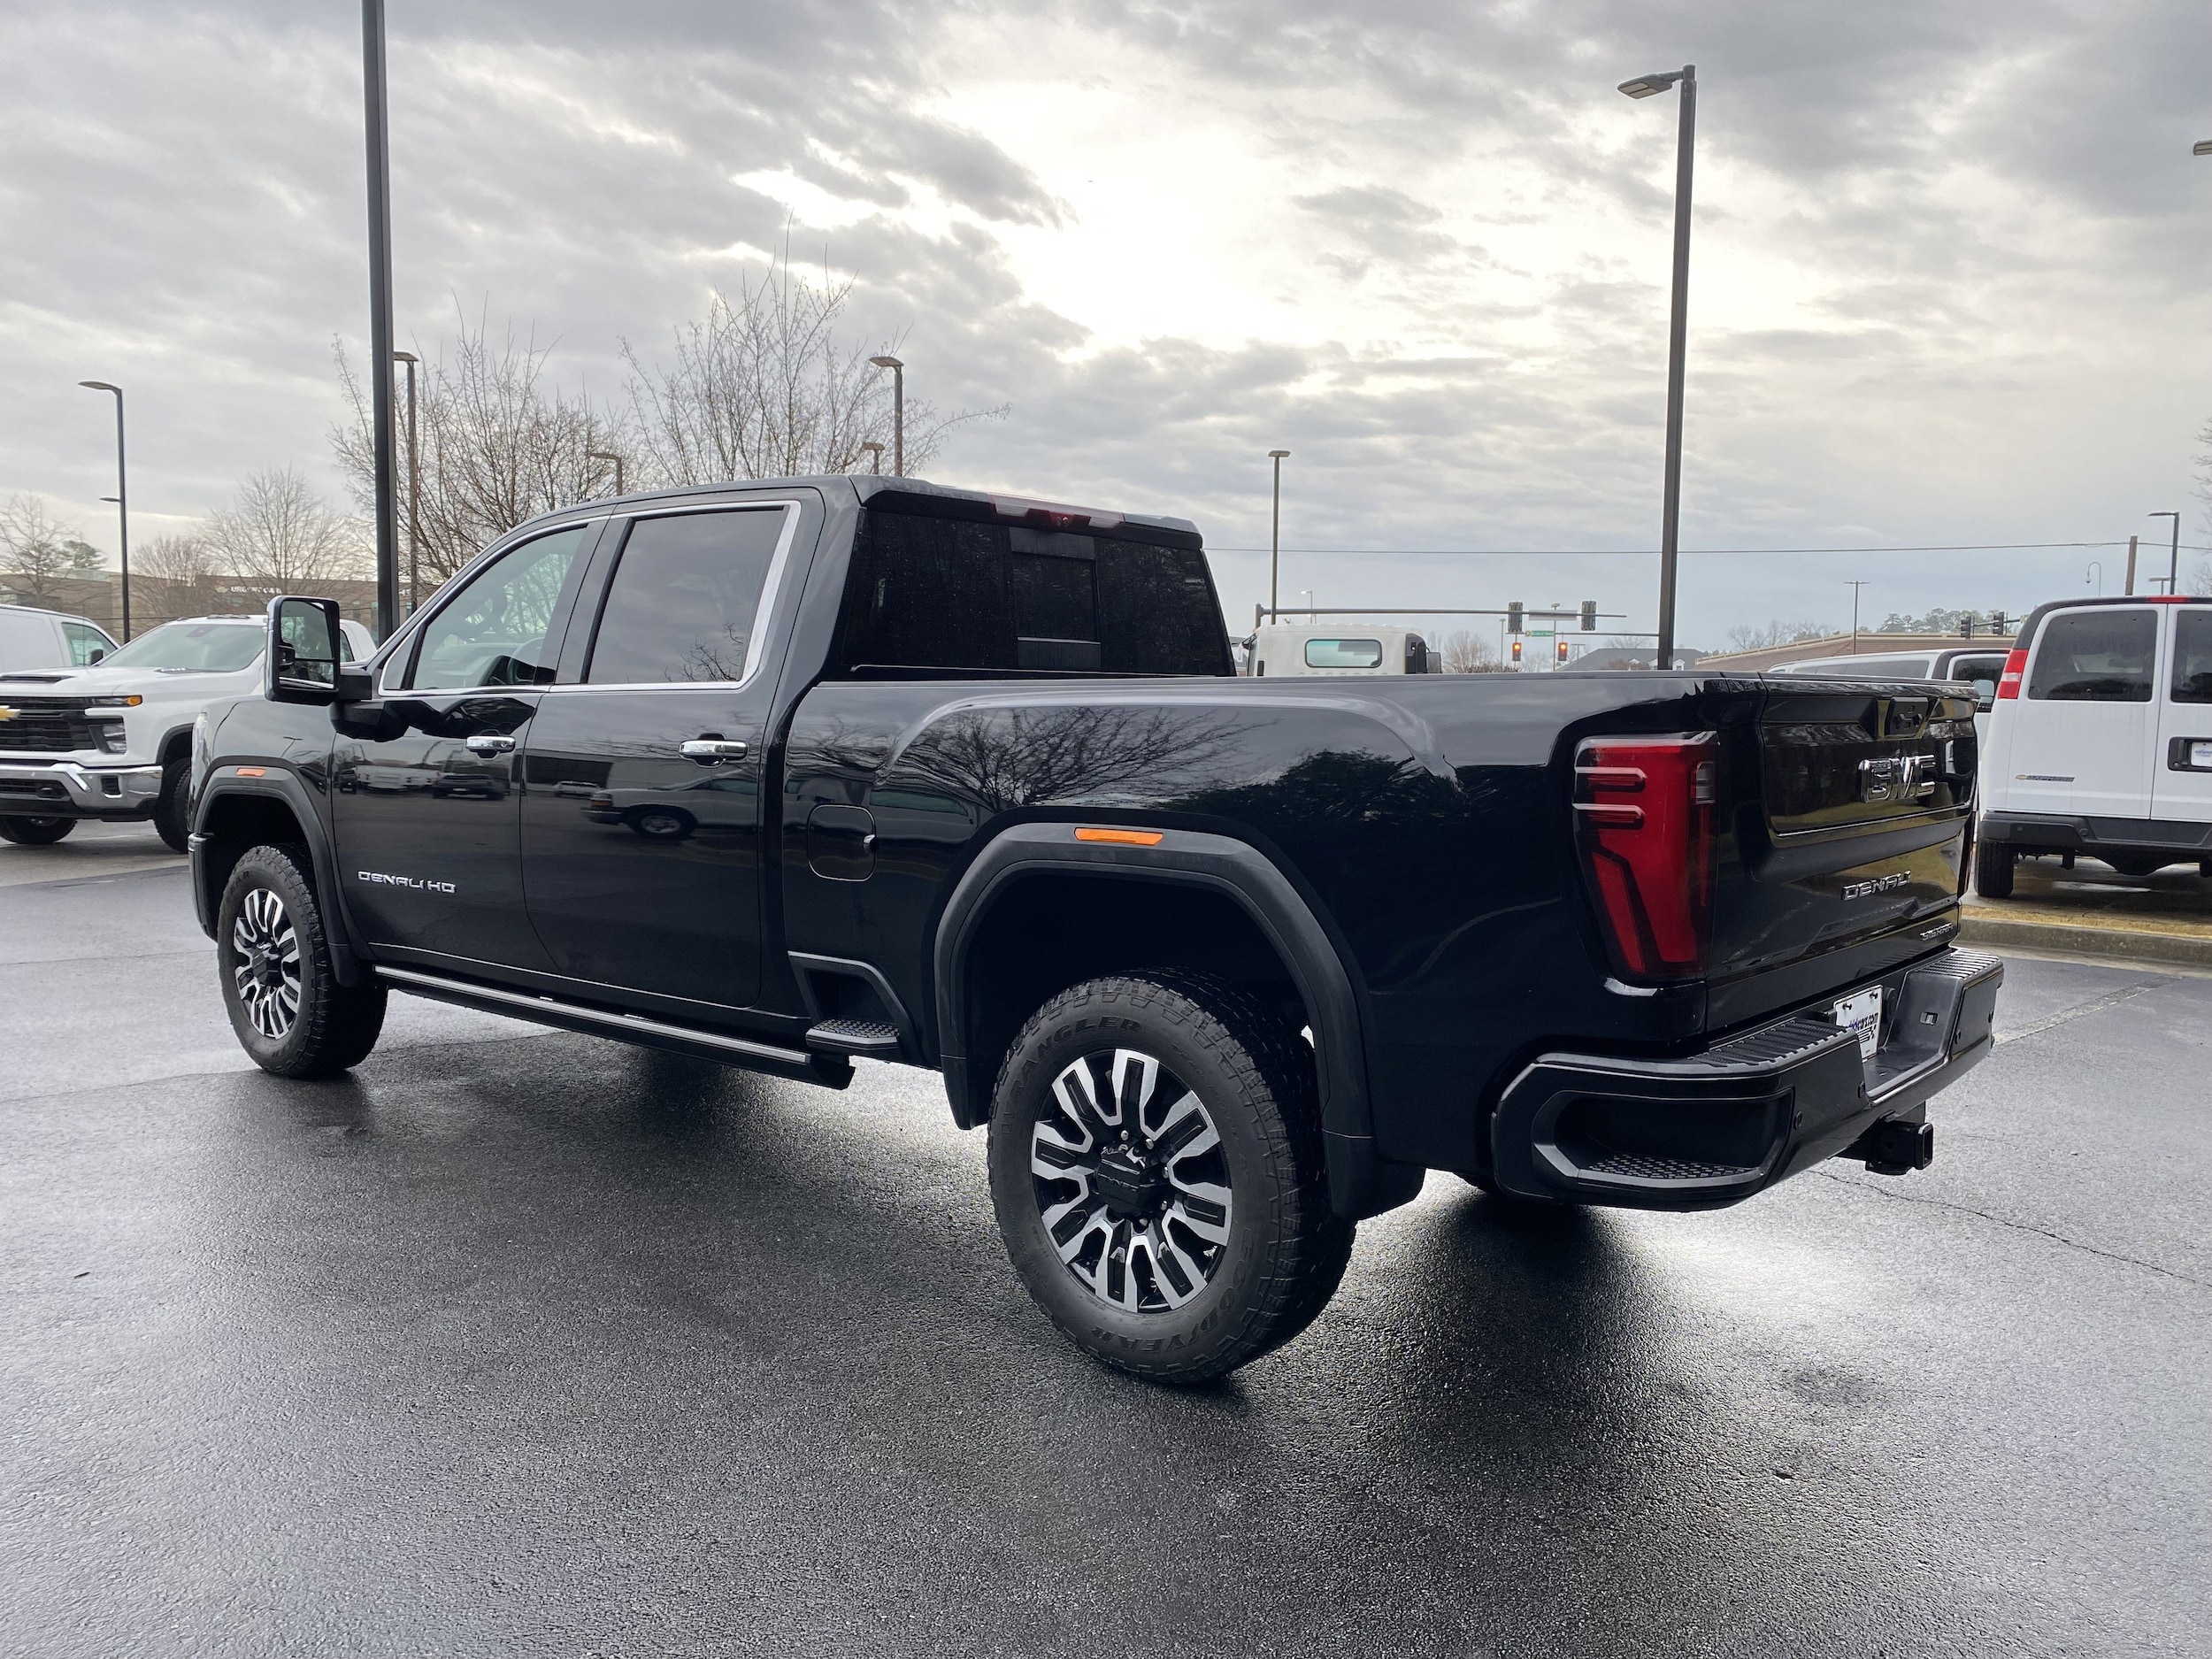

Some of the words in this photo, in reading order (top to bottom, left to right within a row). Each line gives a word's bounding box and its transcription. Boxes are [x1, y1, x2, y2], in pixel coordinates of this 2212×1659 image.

[1859, 754, 1936, 803] GMC
[357, 871, 424, 889] DENALI
[427, 880, 457, 894] HD
[1841, 870, 1911, 901] DENALI
